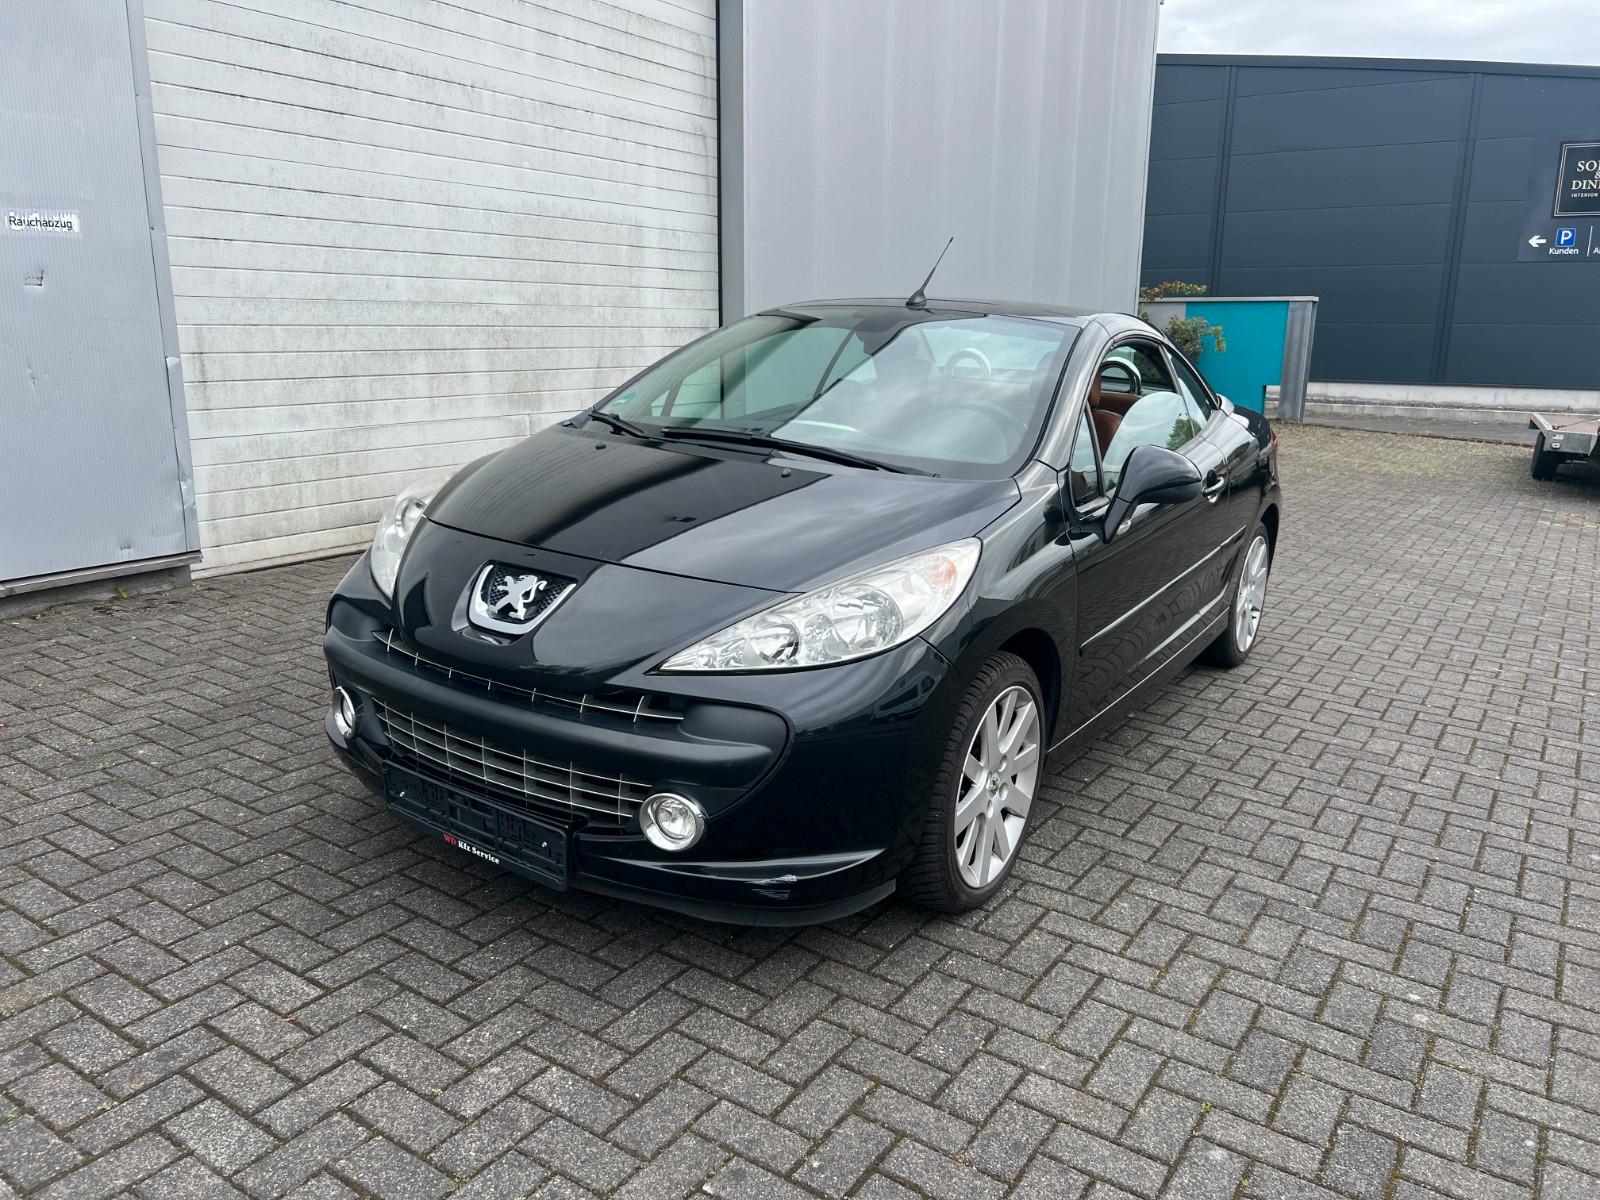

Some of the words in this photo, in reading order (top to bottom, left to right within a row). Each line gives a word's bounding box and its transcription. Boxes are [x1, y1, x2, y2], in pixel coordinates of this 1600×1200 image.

[8, 216, 72, 230] Rauchabzug
[1560, 230, 1572, 244] P
[1549, 247, 1579, 255] Kunden
[458, 840, 471, 851] Kfz
[472, 847, 499, 864] Service
